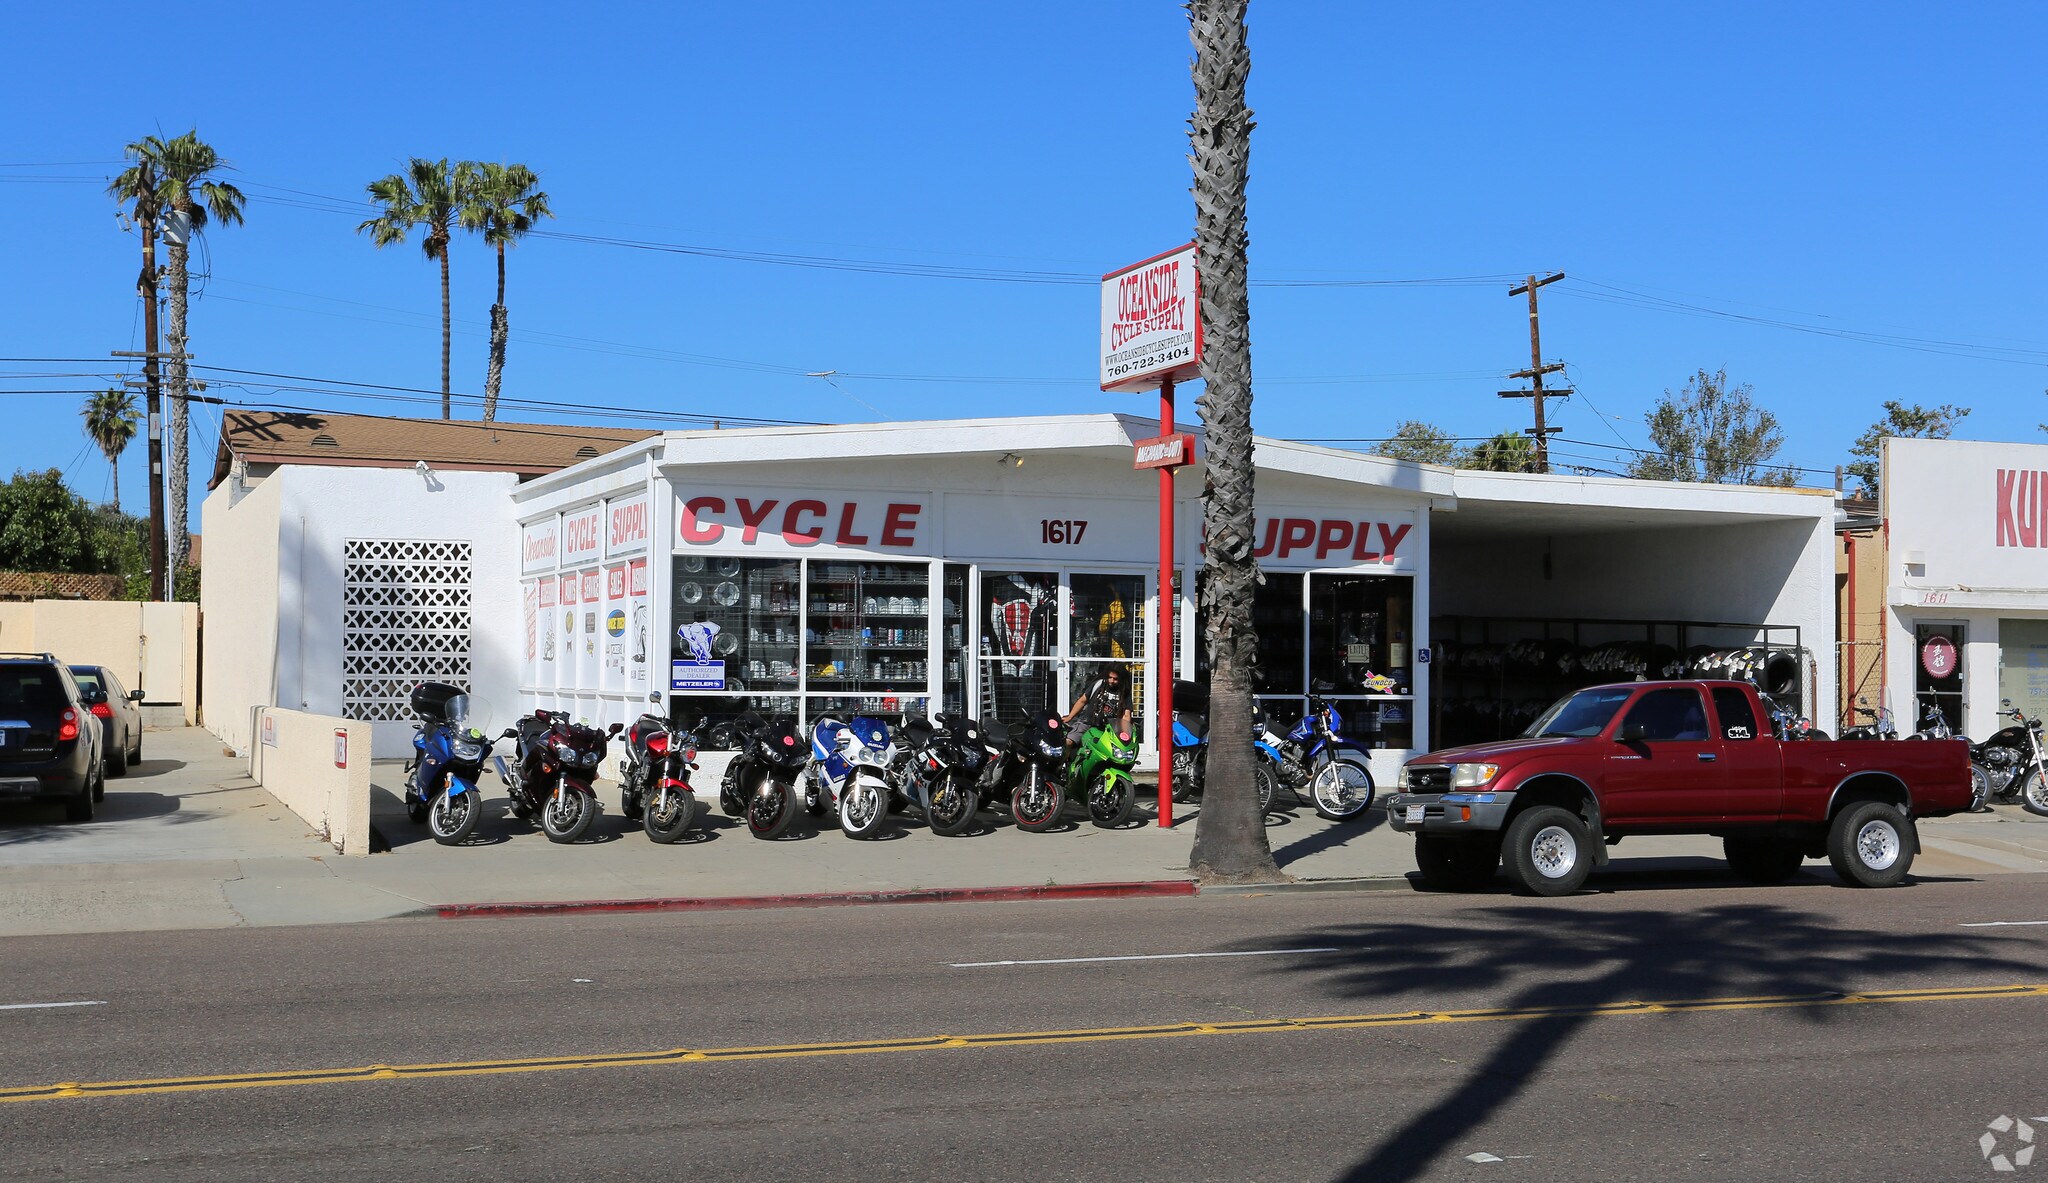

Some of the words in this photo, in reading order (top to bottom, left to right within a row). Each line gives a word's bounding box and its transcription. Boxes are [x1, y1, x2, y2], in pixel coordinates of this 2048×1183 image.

[1118, 260, 1179, 322] OCEANSIDE
[1112, 320, 1142, 351] CYCLE
[1144, 296, 1186, 333] SUPPLY
[1105, 331, 1193, 366] WWW.OCEANSIDECYCLESUPPLY.COM
[1107, 346, 1190, 377] 760-722-3404
[567, 514, 598, 554] CYCLE
[680, 496, 922, 547] CYCLE
[1041, 519, 1088, 545] 1617
[1200, 518, 1413, 563] UPPLY
[1923, 592, 1948, 604] 1611
